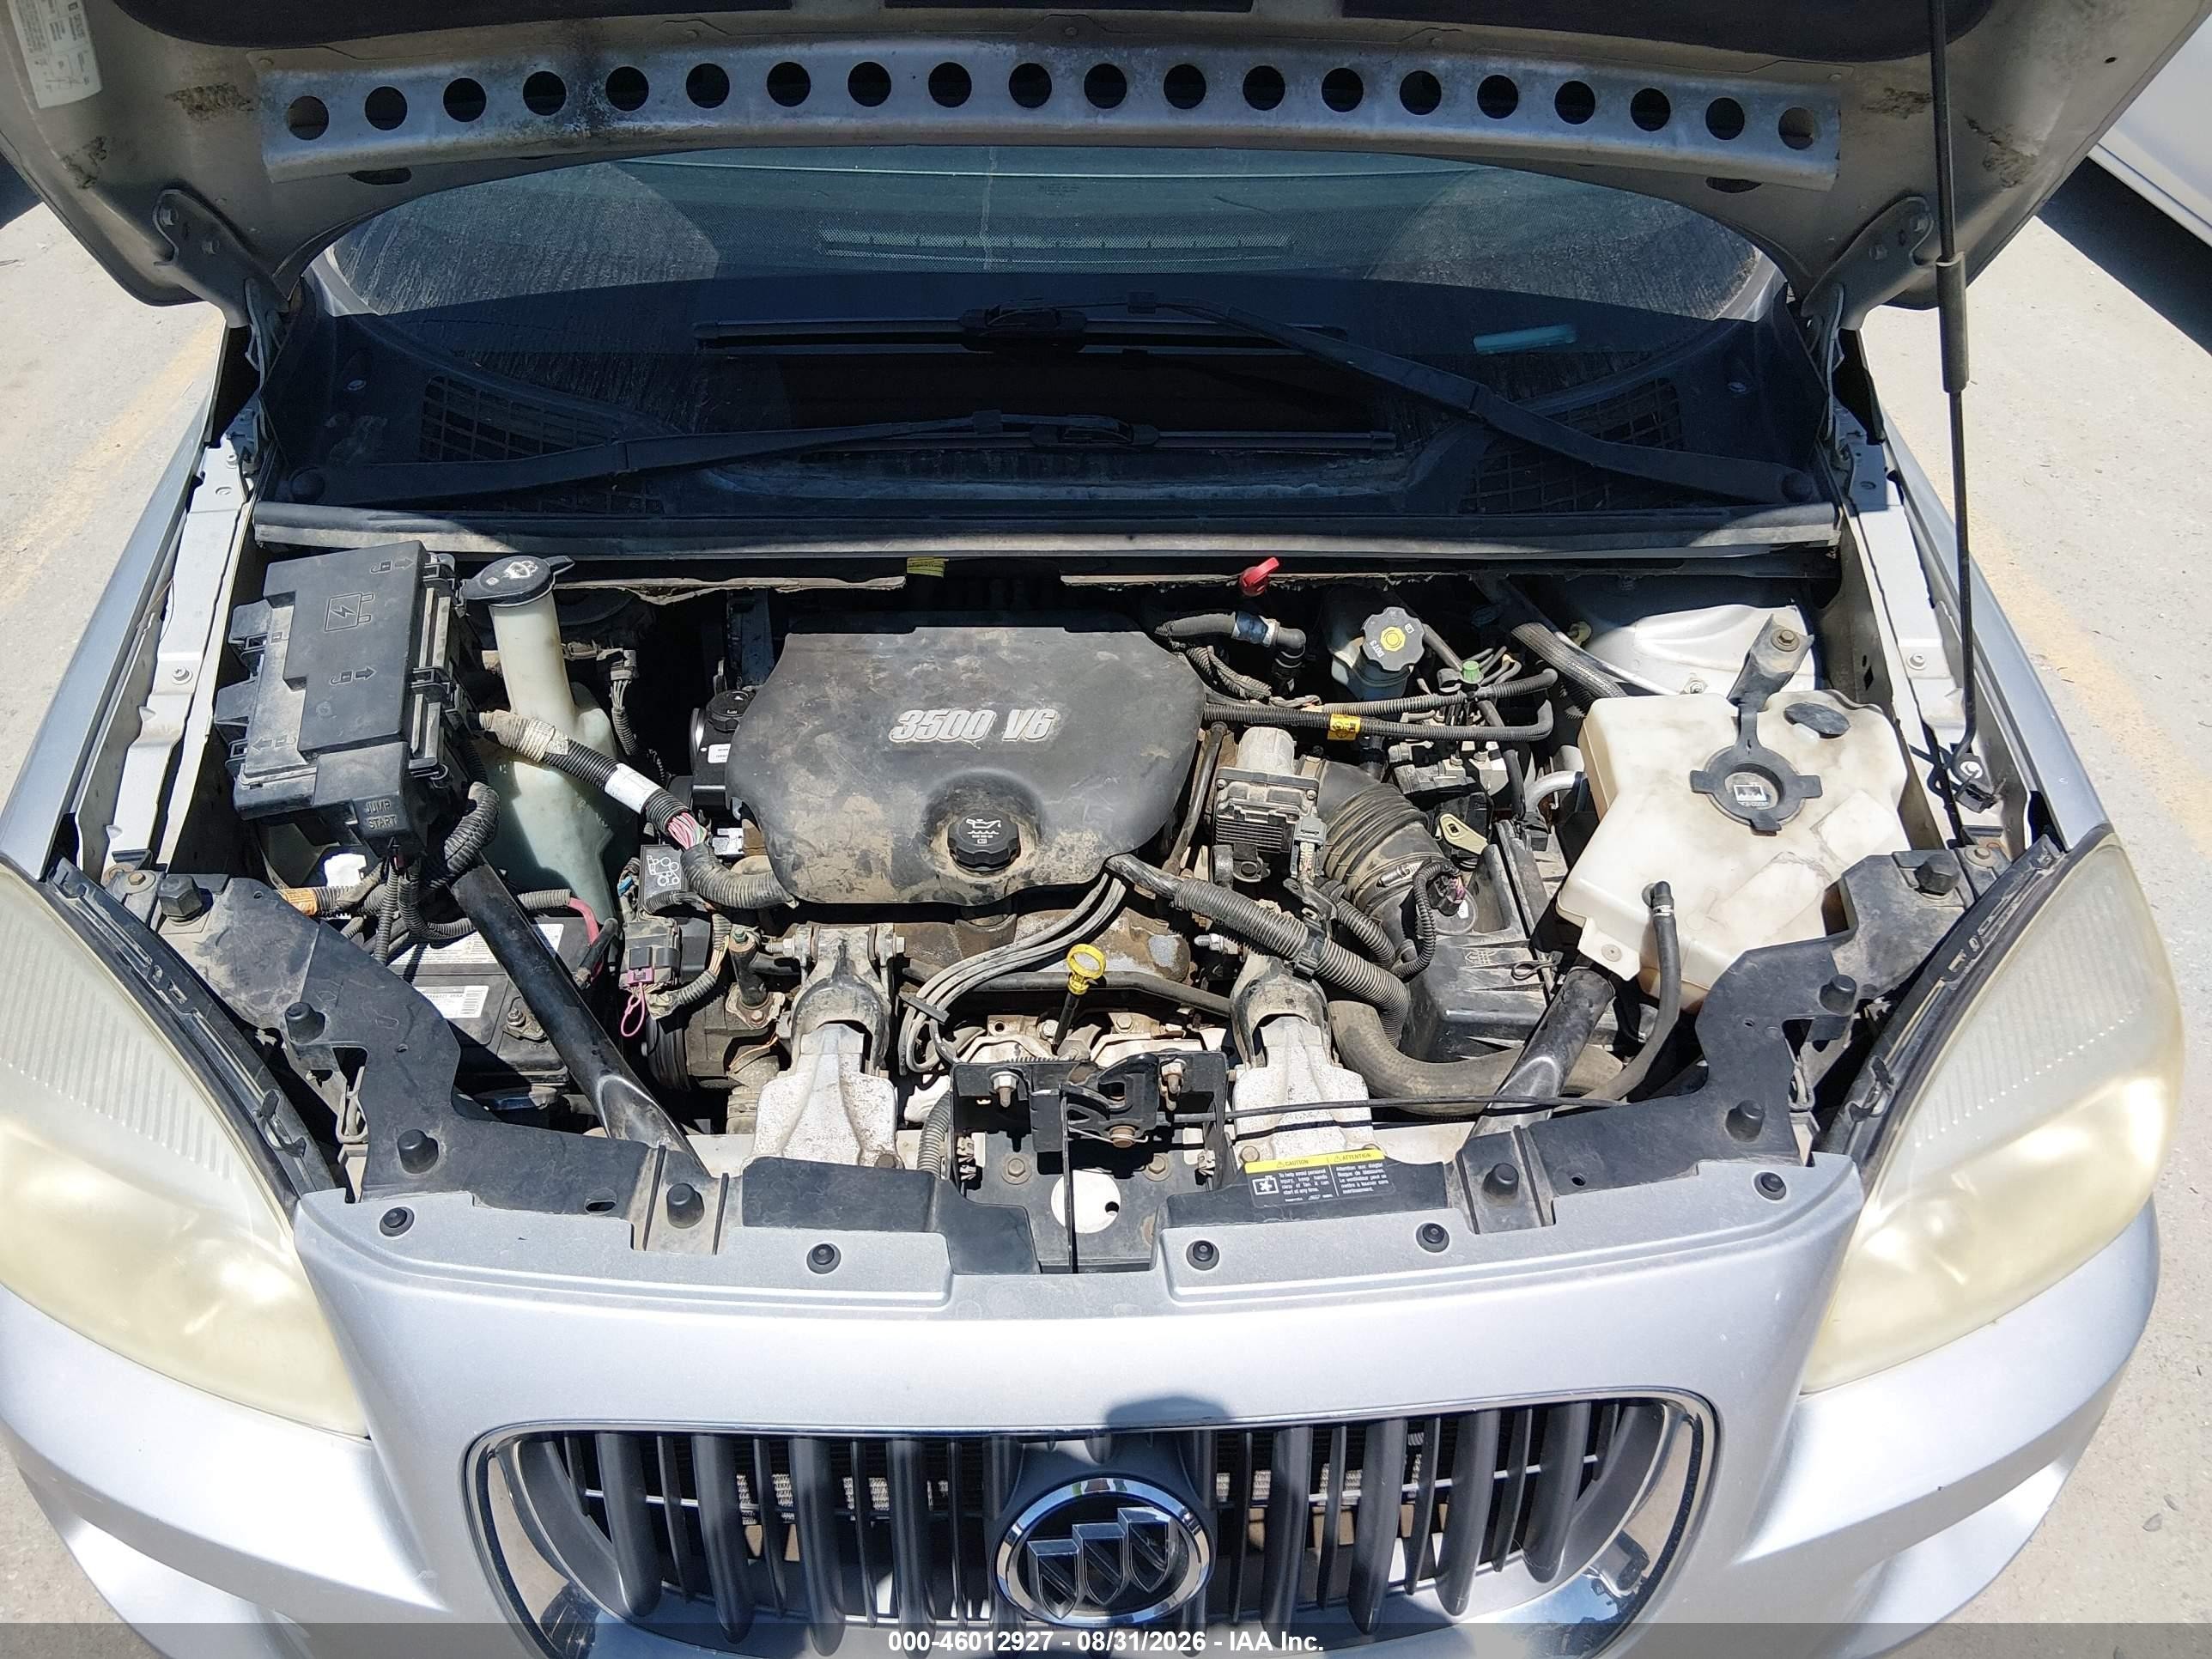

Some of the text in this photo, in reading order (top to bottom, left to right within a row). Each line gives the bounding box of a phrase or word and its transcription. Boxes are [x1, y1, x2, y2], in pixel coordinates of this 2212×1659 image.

[890, 708, 1057, 742] 3500 V6
[366, 799, 391, 814] JUMP
[368, 815, 398, 830] START
[1342, 1152, 1371, 1161] ATTENTION
